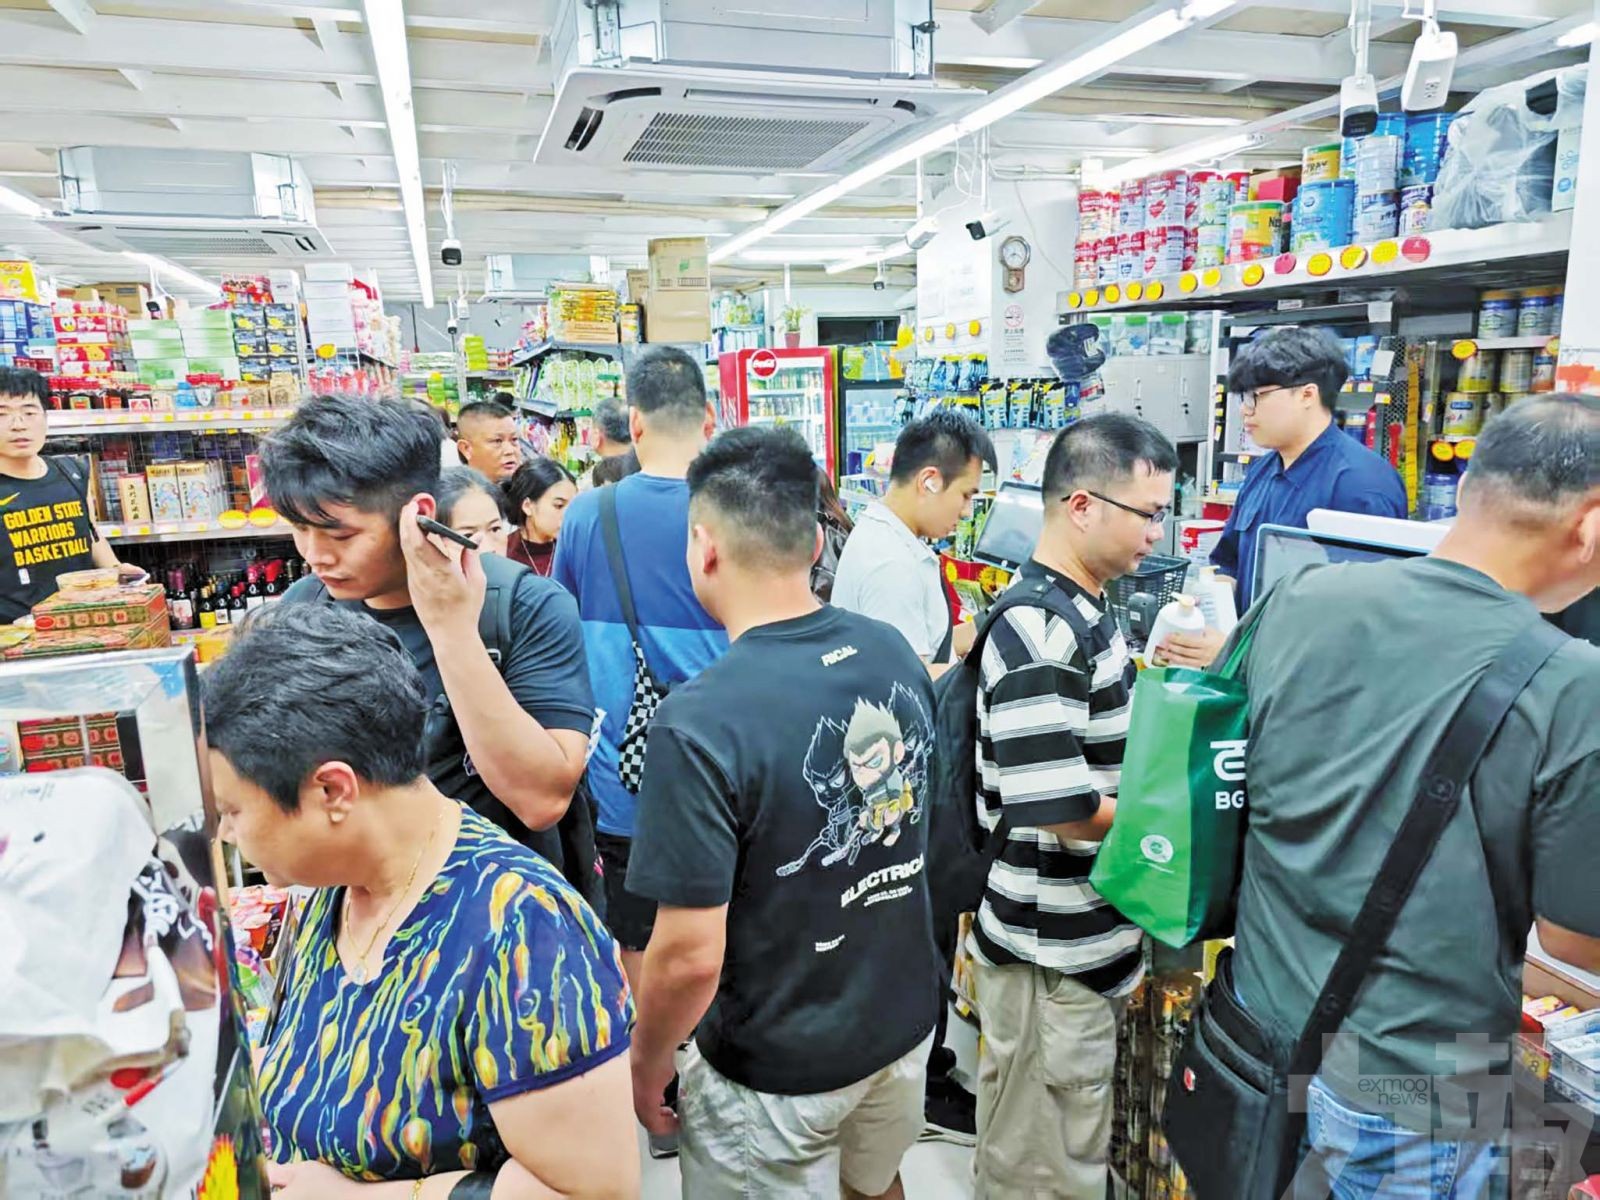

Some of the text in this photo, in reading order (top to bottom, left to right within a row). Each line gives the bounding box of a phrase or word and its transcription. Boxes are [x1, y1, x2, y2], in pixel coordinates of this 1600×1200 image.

[3, 501, 84, 530] GOLDEN STATE
[8, 521, 76, 549] WARRIORS
[13, 537, 90, 567] BASKETBALL
